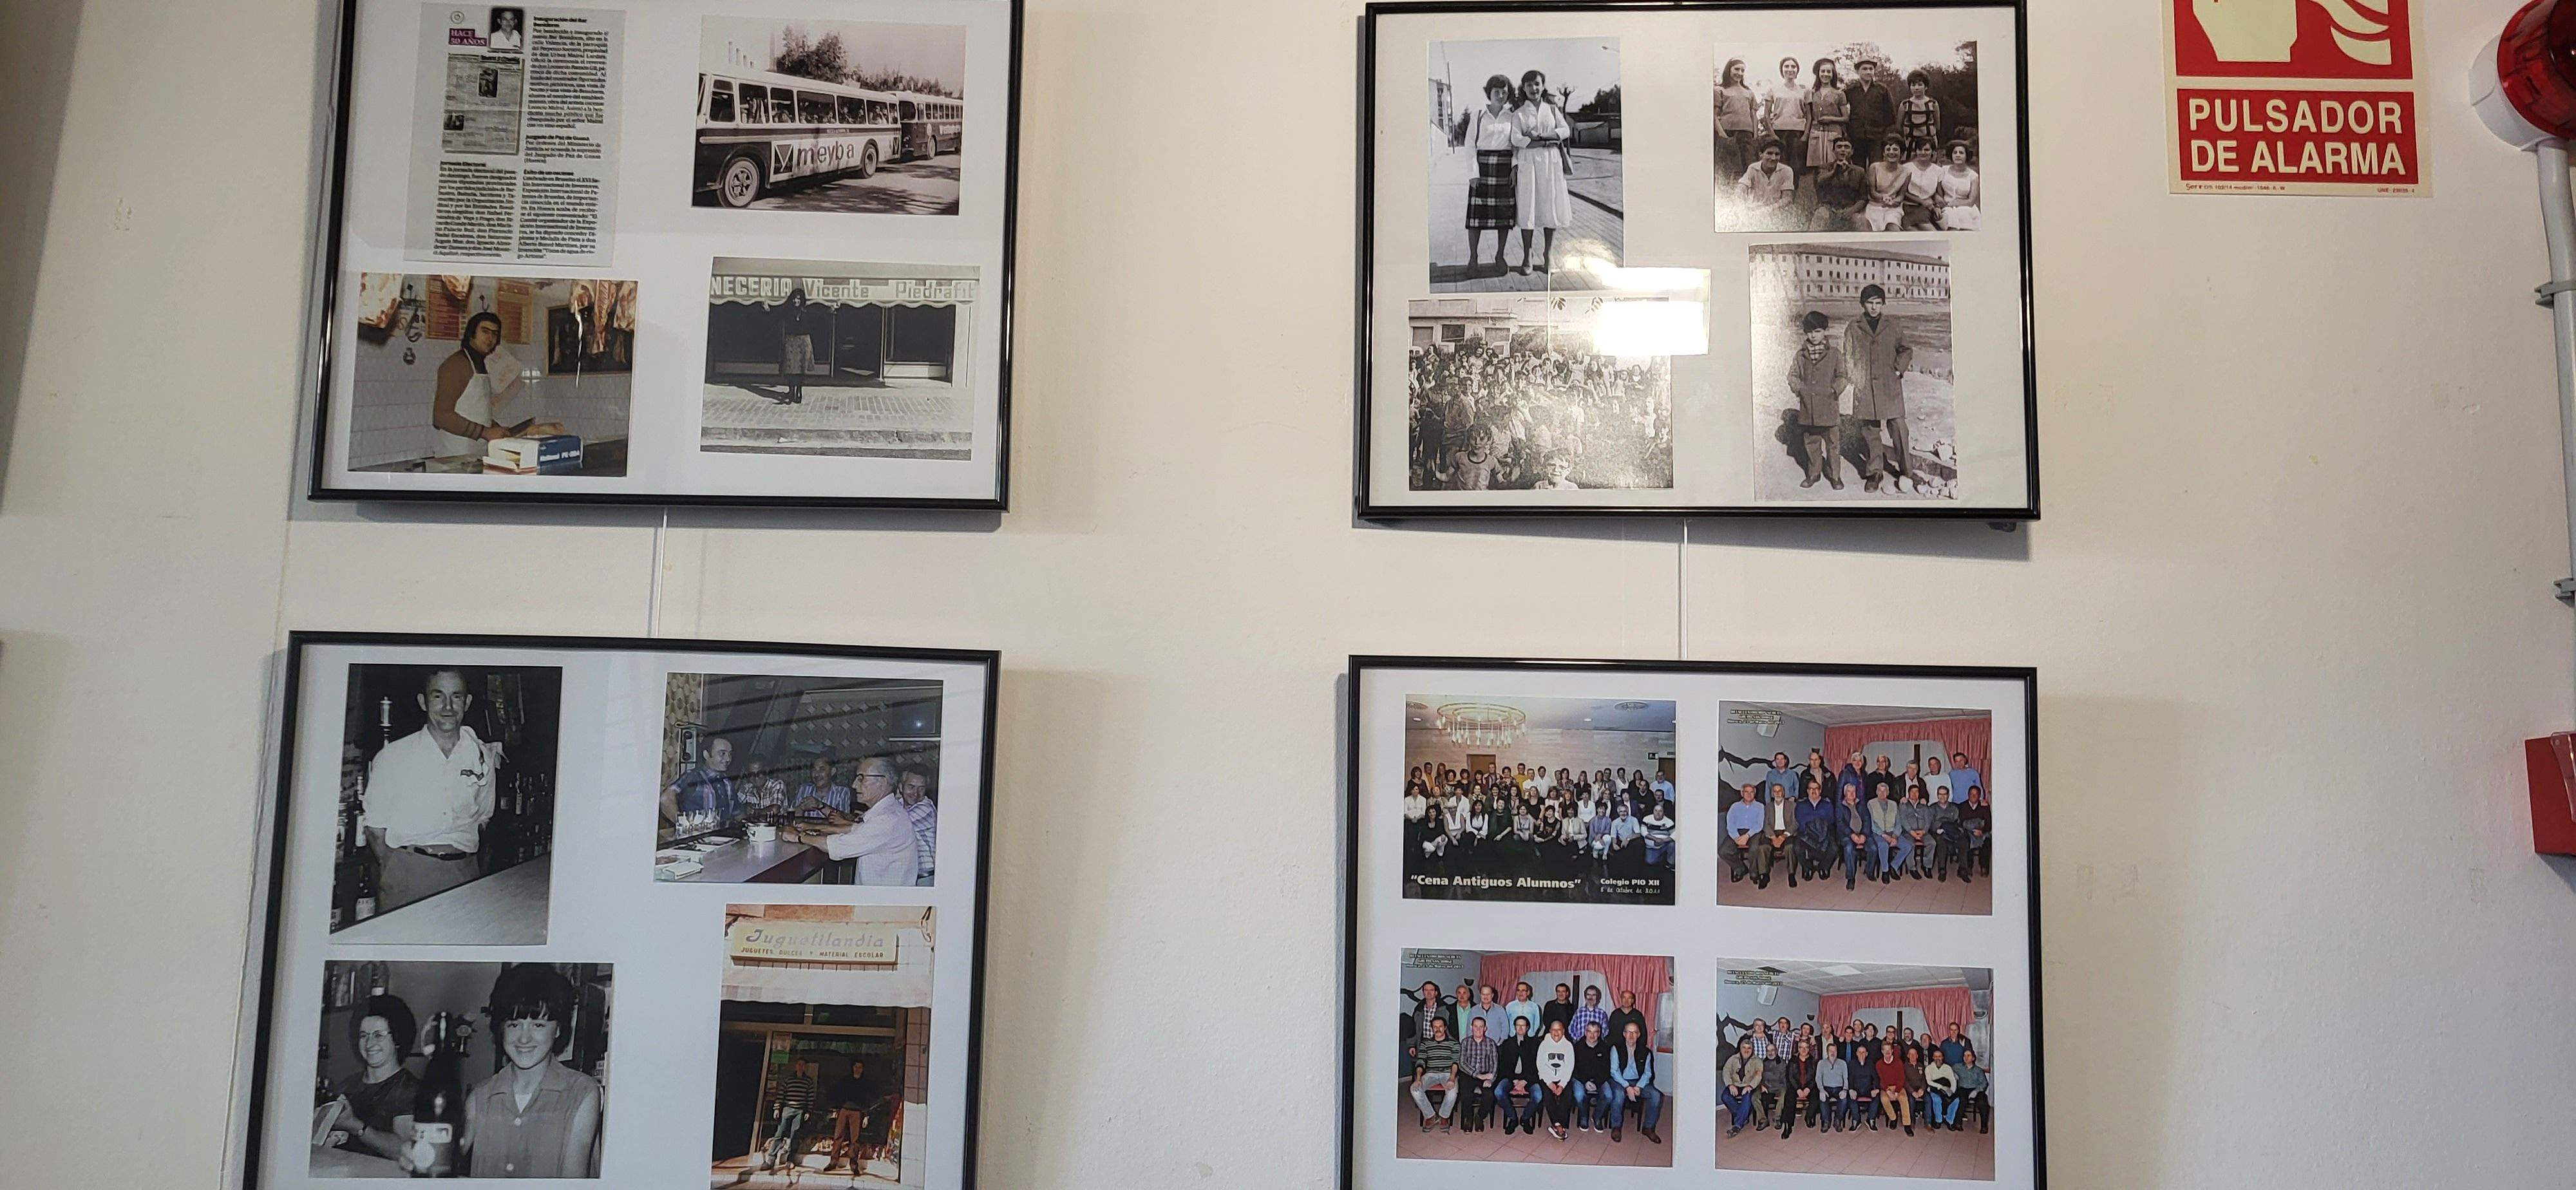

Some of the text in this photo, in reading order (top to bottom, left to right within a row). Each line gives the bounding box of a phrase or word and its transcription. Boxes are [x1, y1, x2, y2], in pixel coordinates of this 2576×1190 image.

[462, 37, 485, 45] AÑOS
[2189, 99, 2403, 134] PULSADOR
[797, 140, 855, 167] meyba
[2190, 140, 2407, 175] DE ALARMA
[710, 276, 792, 297] NECERIA
[803, 279, 869, 298] Vicente
[1452, 875, 1512, 889] Antiguos
[746, 929, 884, 949] Juguetilandia
